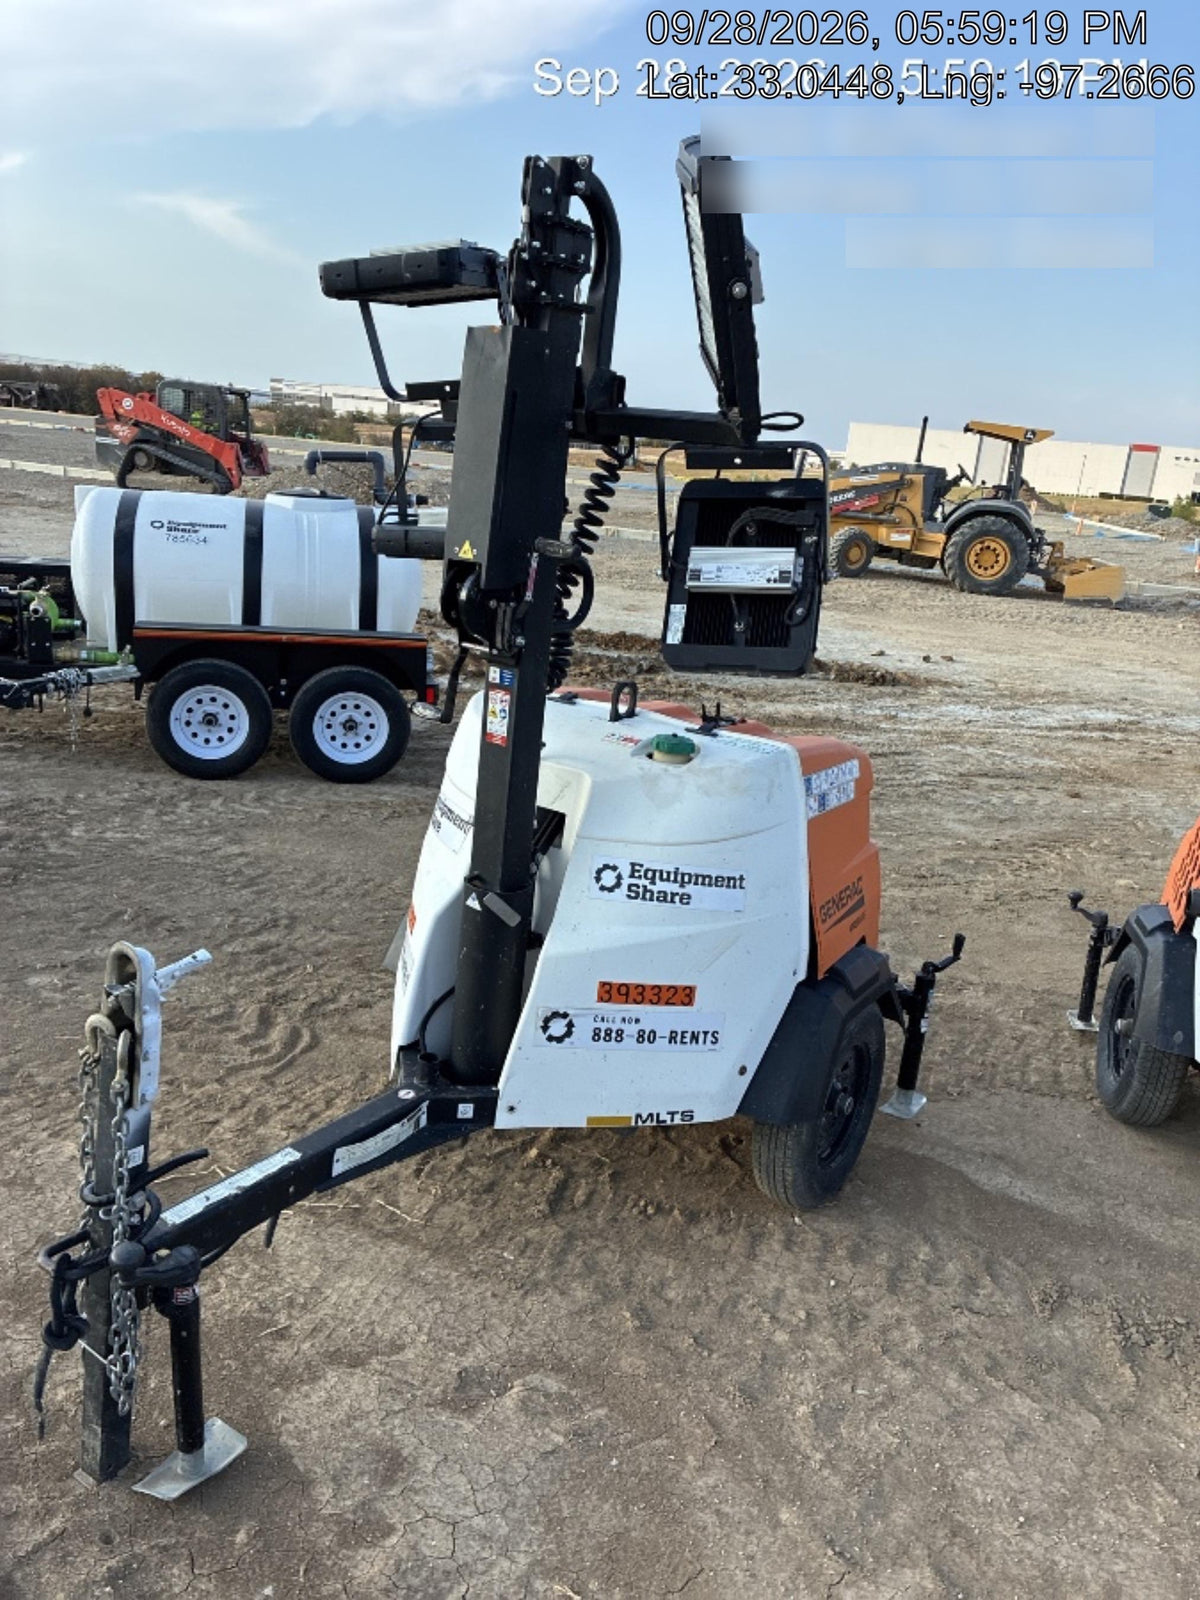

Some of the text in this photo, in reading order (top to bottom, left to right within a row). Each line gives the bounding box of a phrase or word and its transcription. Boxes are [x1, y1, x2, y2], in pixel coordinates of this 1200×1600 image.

[629, 861, 745, 889] Equipment
[626, 883, 692, 905] Share
[819, 875, 863, 924] GENERAC
[600, 983, 694, 1007] 393323
[593, 1014, 641, 1025] CALL NOW
[591, 1027, 720, 1046] 888-80-RENTS
[634, 1110, 695, 1126] MLTS
